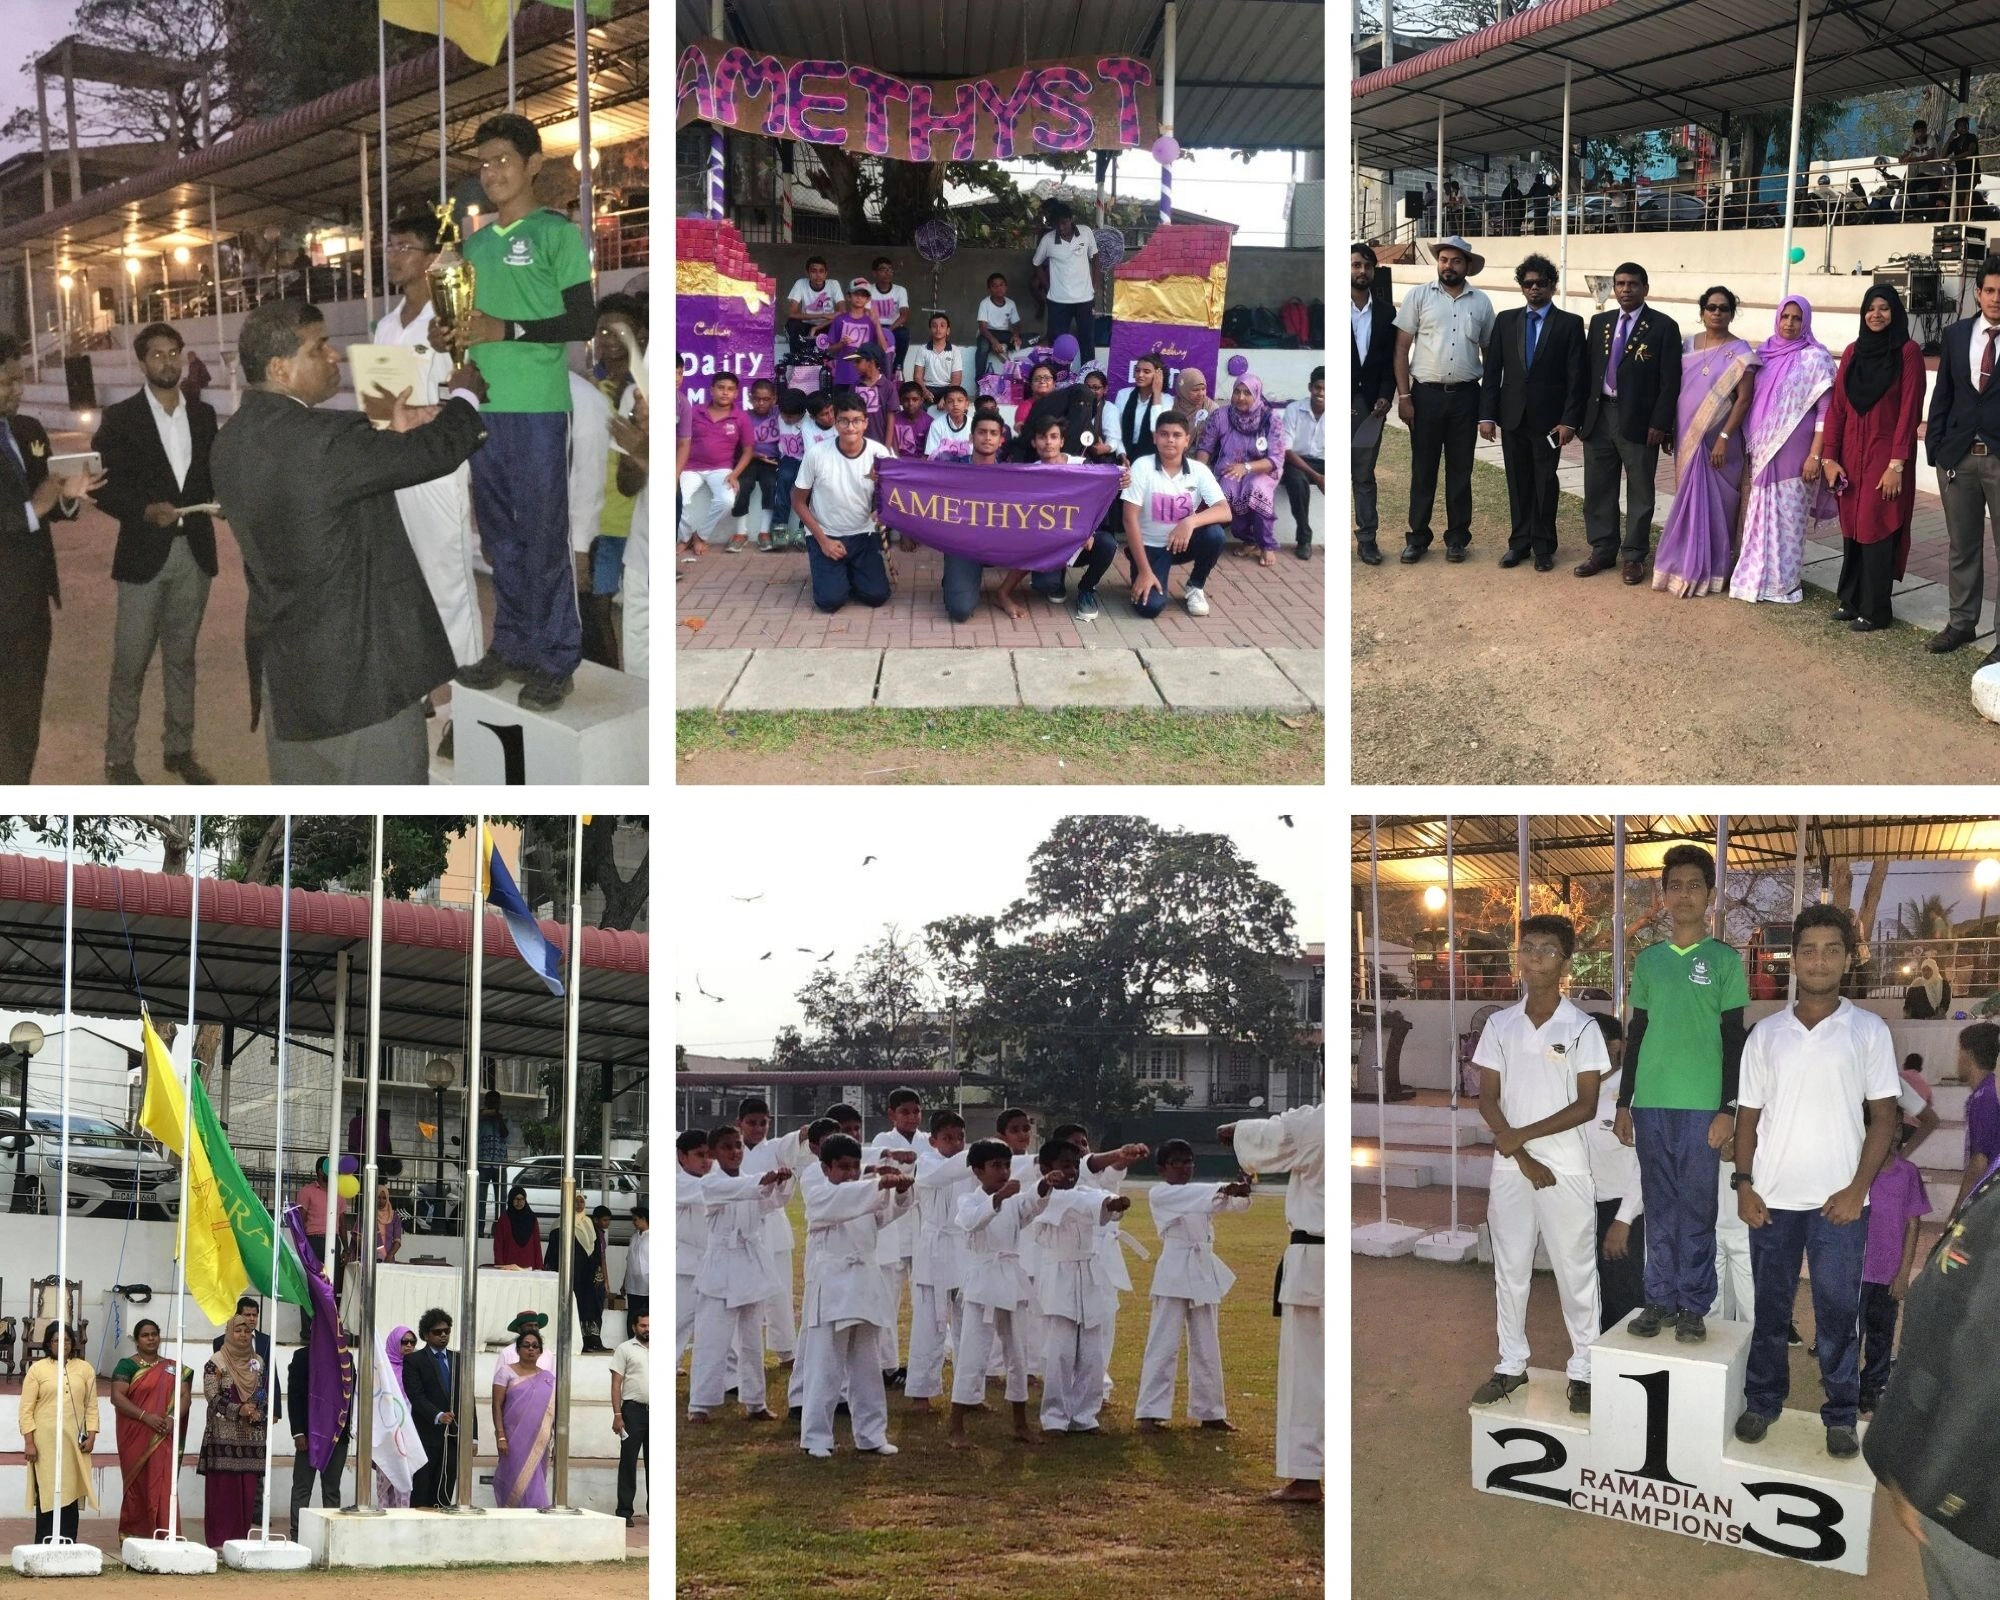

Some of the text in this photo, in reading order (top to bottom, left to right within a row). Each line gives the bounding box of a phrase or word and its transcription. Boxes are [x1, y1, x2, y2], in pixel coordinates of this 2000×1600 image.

[675, 45, 1151, 162] AMETHYST
[680, 352, 763, 377] Dairy
[687, 386, 754, 411] Mk
[887, 487, 1080, 530] AMETHYST
[1161, 496, 1190, 521] 113
[1614, 1370, 1697, 1489] 1
[1486, 1427, 1573, 1508] 2
[1580, 1467, 1733, 1519] RAMADIAN
[1570, 1492, 1743, 1545] CHAMPIONS
[1741, 1481, 1848, 1562] 3
